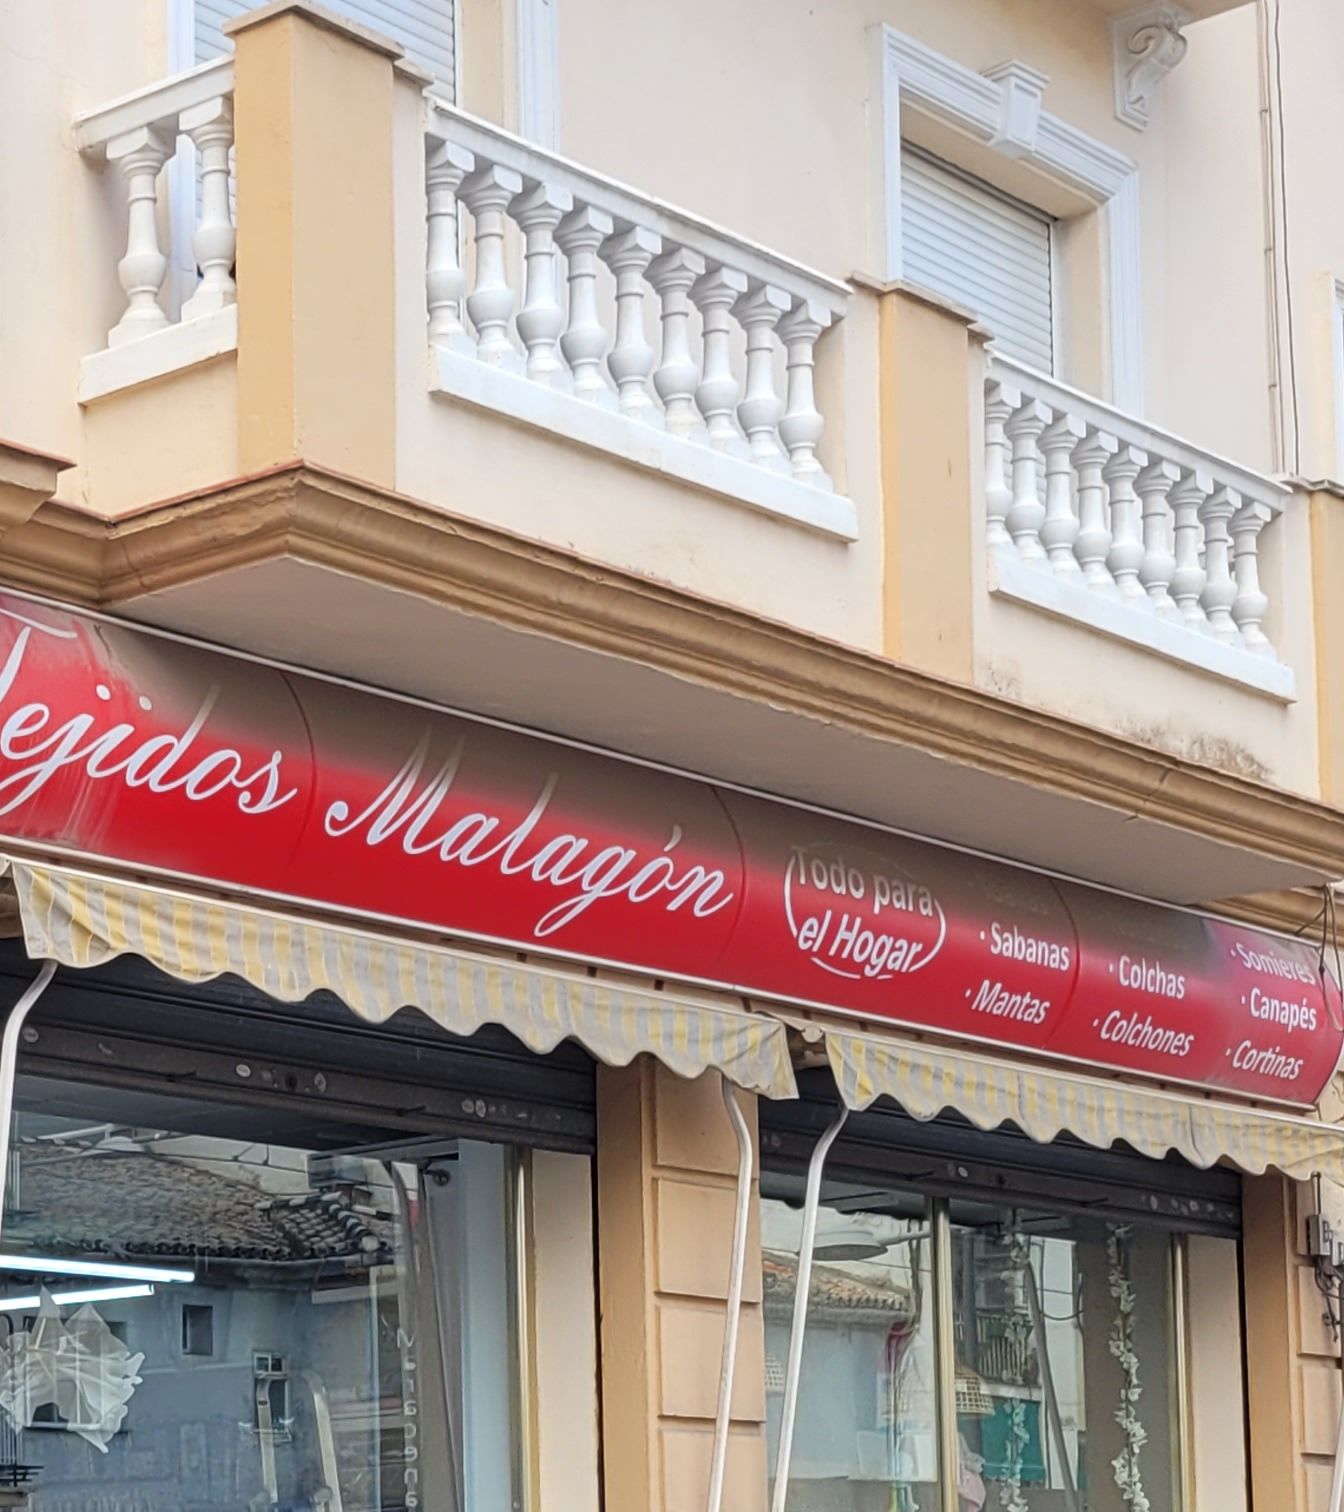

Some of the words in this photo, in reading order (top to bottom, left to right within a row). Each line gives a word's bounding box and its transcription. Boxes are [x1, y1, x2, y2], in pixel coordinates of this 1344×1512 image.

[324, 722, 734, 938] Malagón
[791, 845, 865, 899] Todo
[874, 873, 933, 916] para
[798, 909, 832, 952] el
[828, 912, 923, 978] Hogar
[990, 921, 1070, 972] Sabanas
[1234, 942, 1316, 986] Somieres
[970, 978, 1051, 1025] Mantas
[1118, 955, 1186, 1000] Colchas
[1099, 1009, 1195, 1058] Colchones
[1249, 986, 1317, 1033] Canapés
[1231, 1039, 1304, 1081] Cortinas
